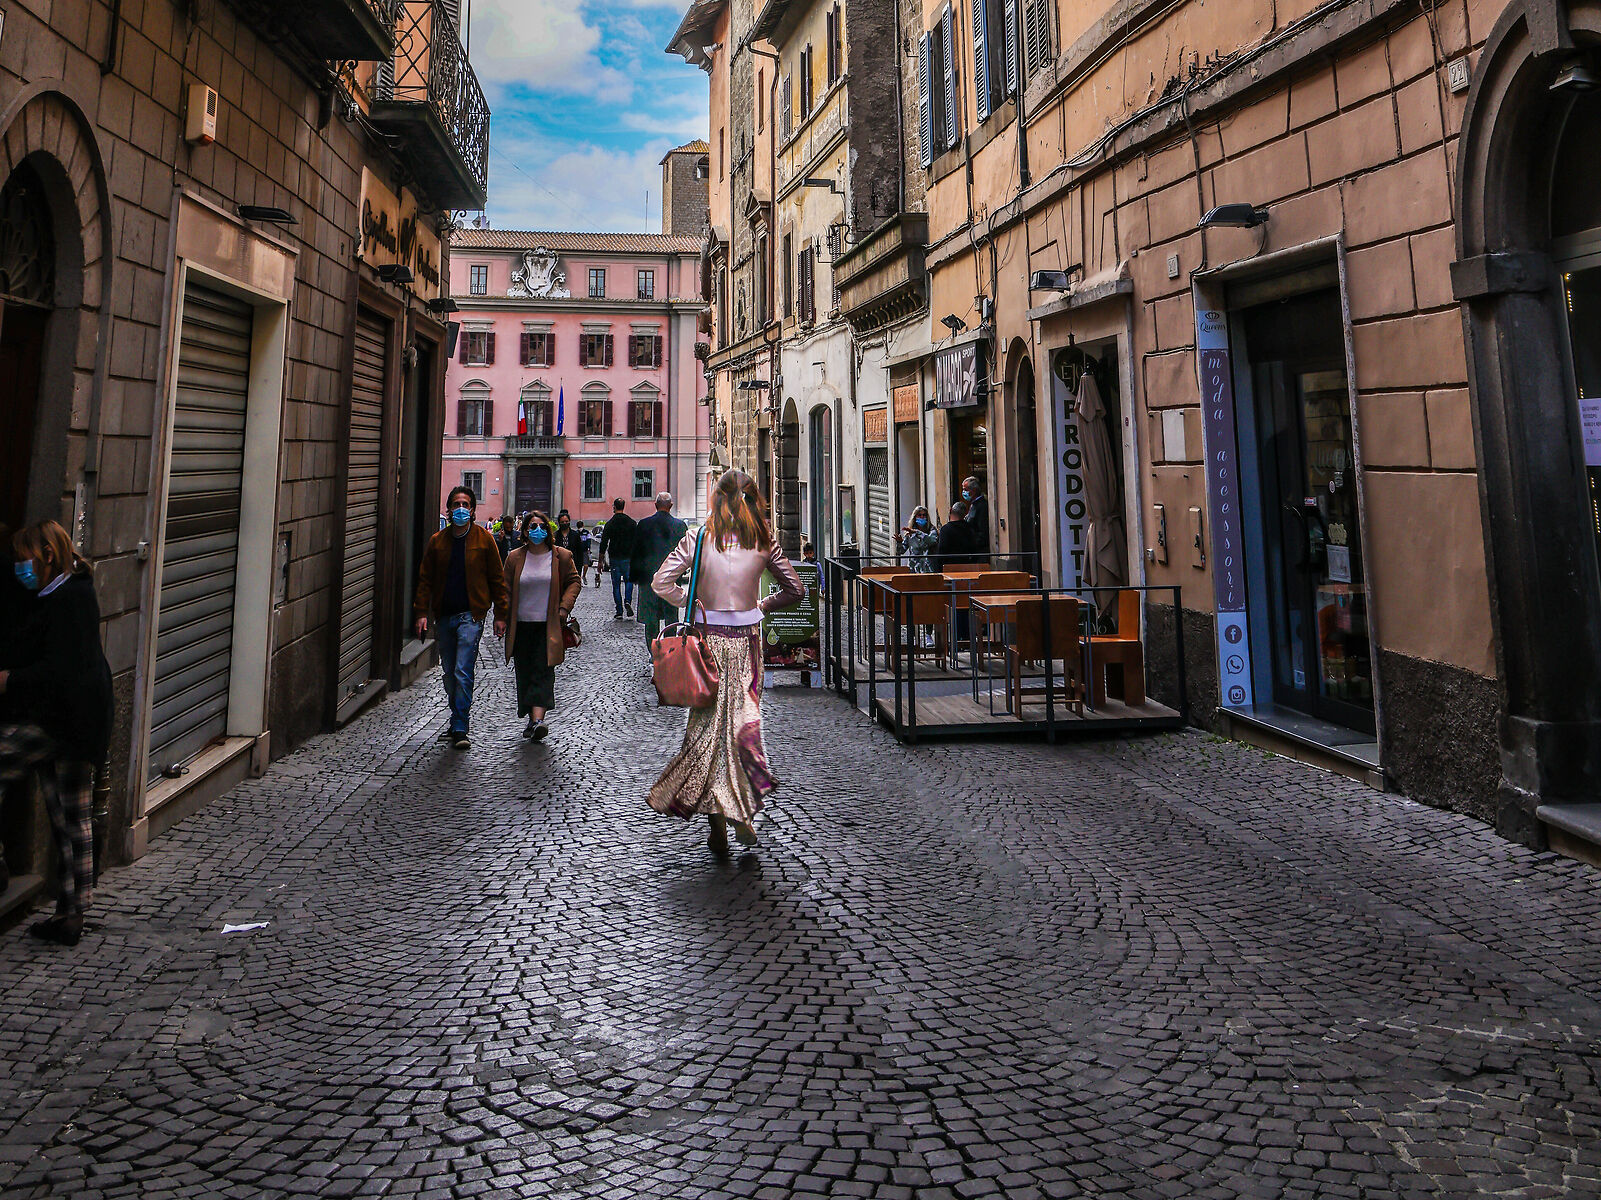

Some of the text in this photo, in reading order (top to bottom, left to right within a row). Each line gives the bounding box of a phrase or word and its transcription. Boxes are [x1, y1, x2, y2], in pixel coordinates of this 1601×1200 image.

[1451, 63, 1464, 84] 22
[962, 346, 976, 358] SPORT
[1200, 322, 1226, 333] Queens
[943, 351, 962, 402] MARCO
[1208, 357, 1224, 420] moda
[1063, 400, 1086, 596] PRODOTTI
[1216, 449, 1235, 603] accessori
